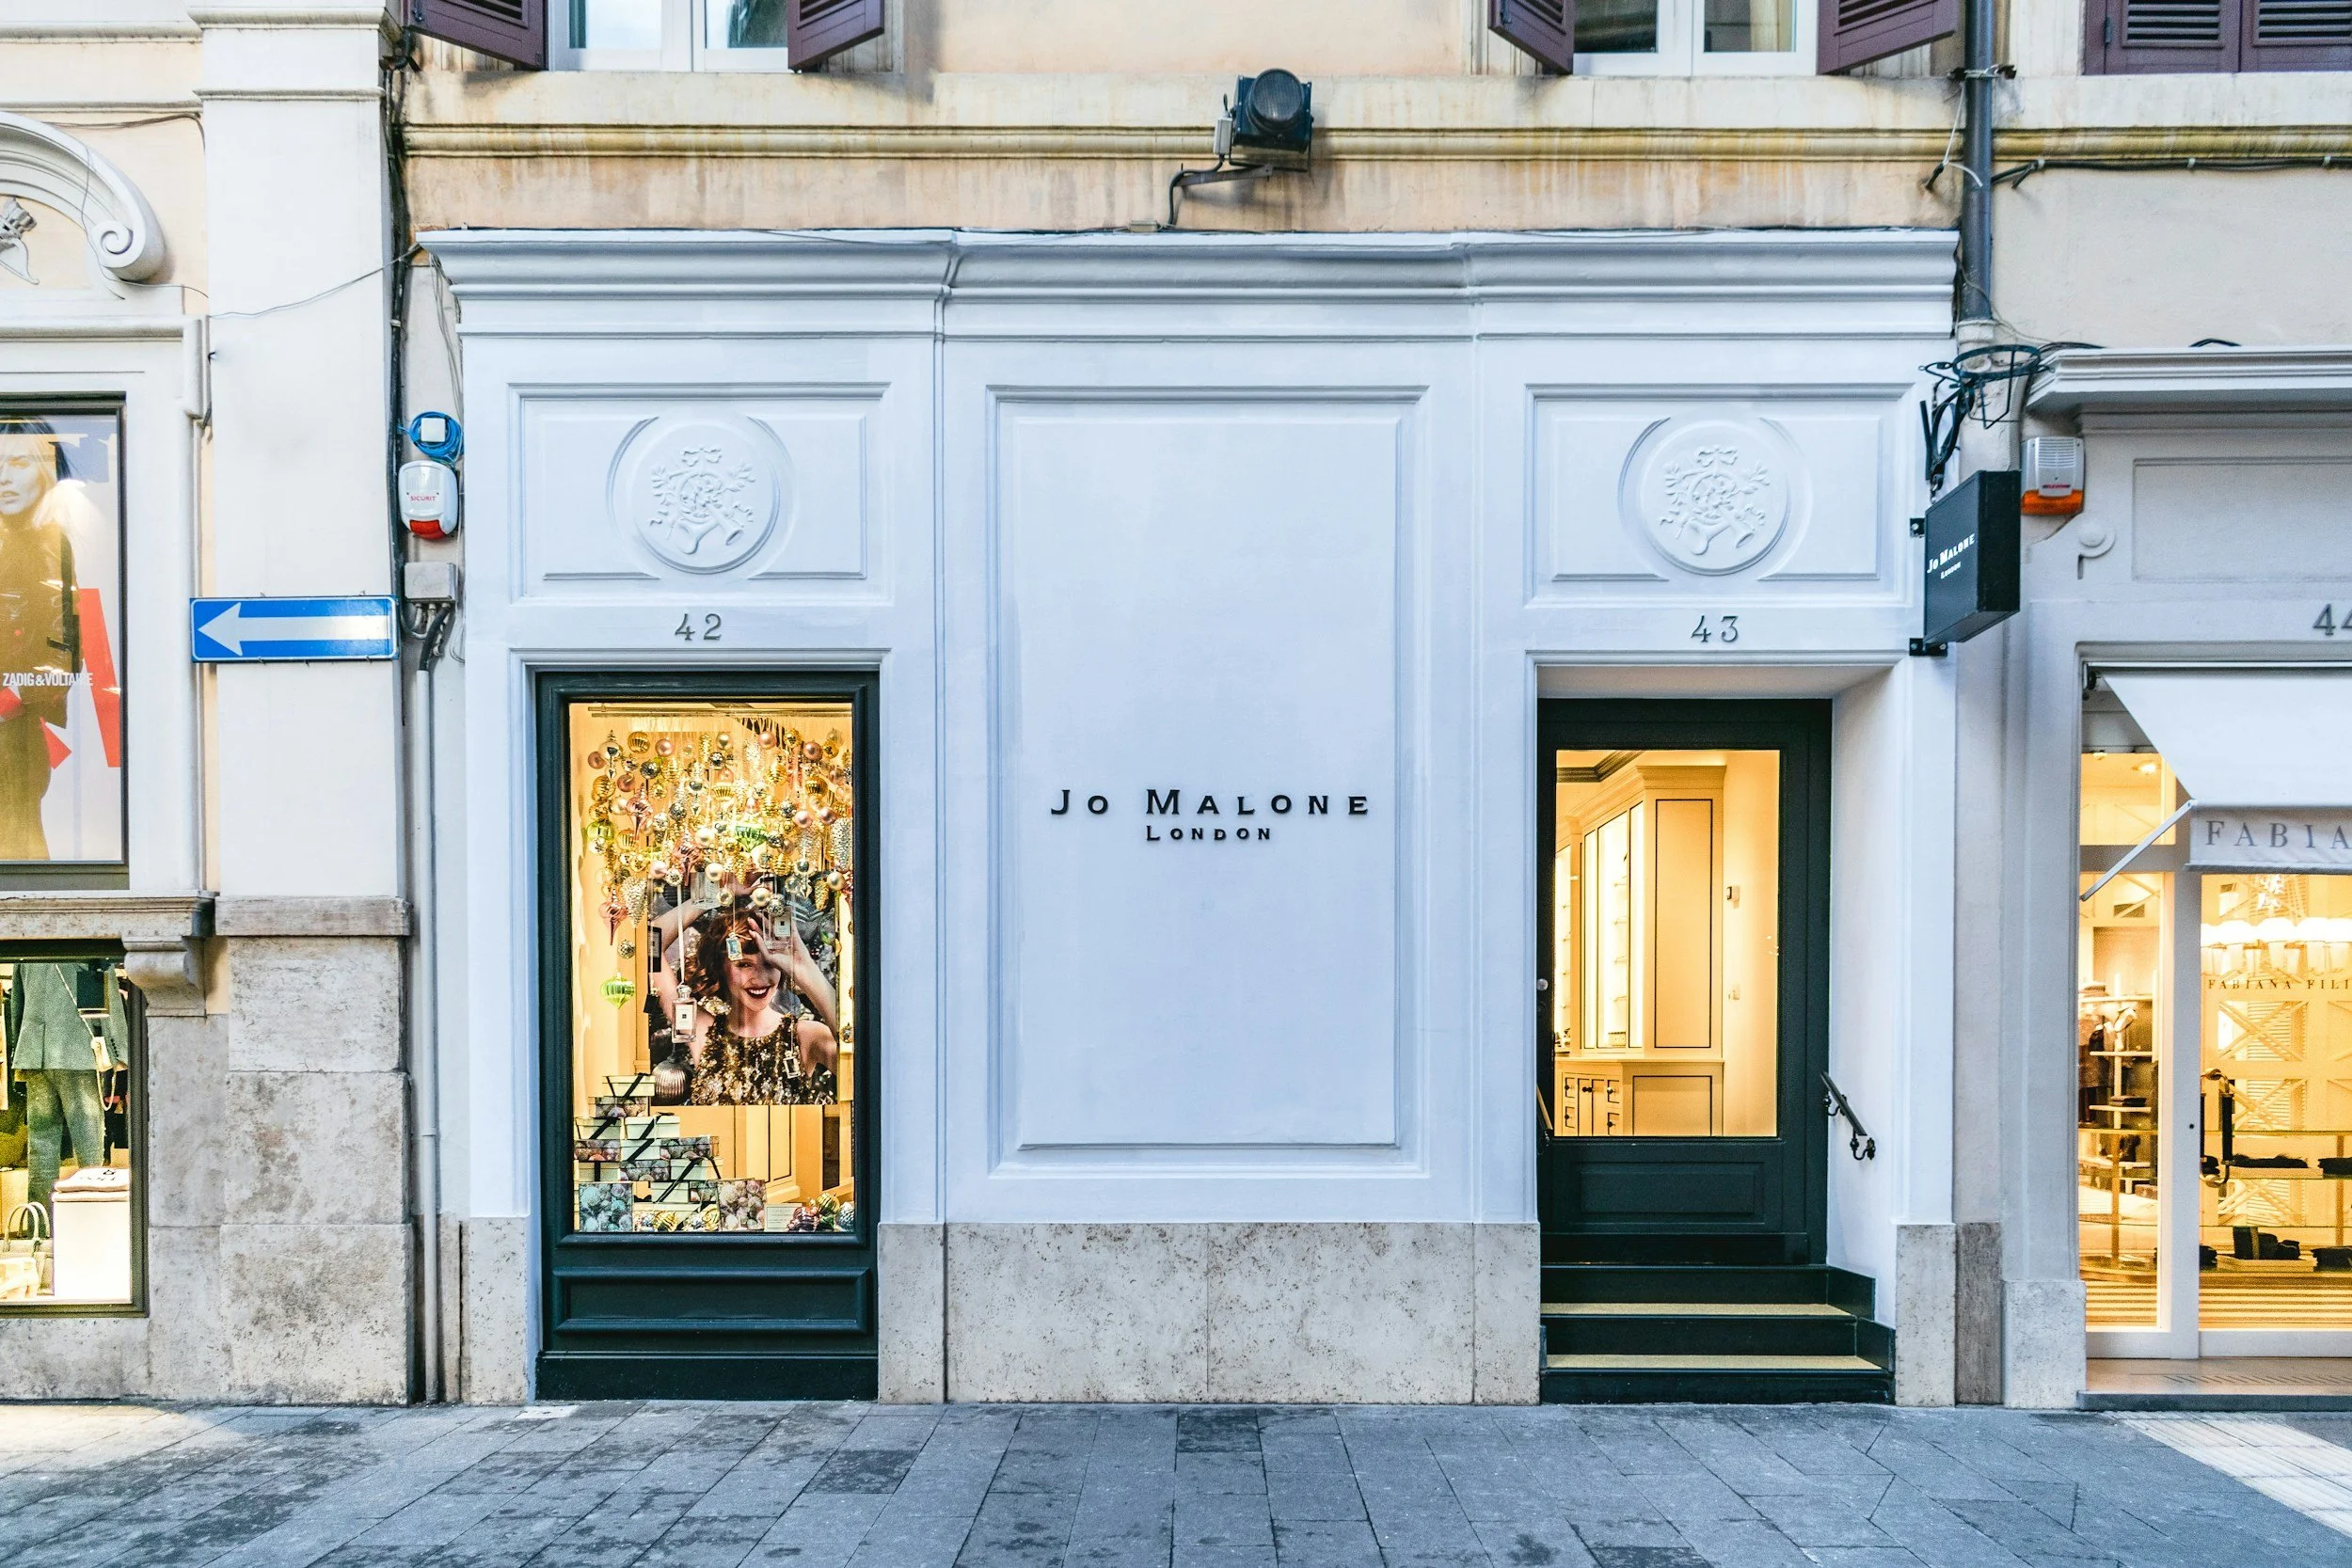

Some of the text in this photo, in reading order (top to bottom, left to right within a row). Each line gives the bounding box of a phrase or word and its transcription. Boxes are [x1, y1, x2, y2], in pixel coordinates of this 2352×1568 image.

[675, 612, 723, 641] 42
[1691, 615, 1739, 643] 43
[2, 673, 94, 687] ZADIG&VOLTAIE
[1146, 825, 1271, 841] LONDON
[2205, 820, 2352, 849] FABIA
[2208, 979, 2349, 990] FABIANA FILI
